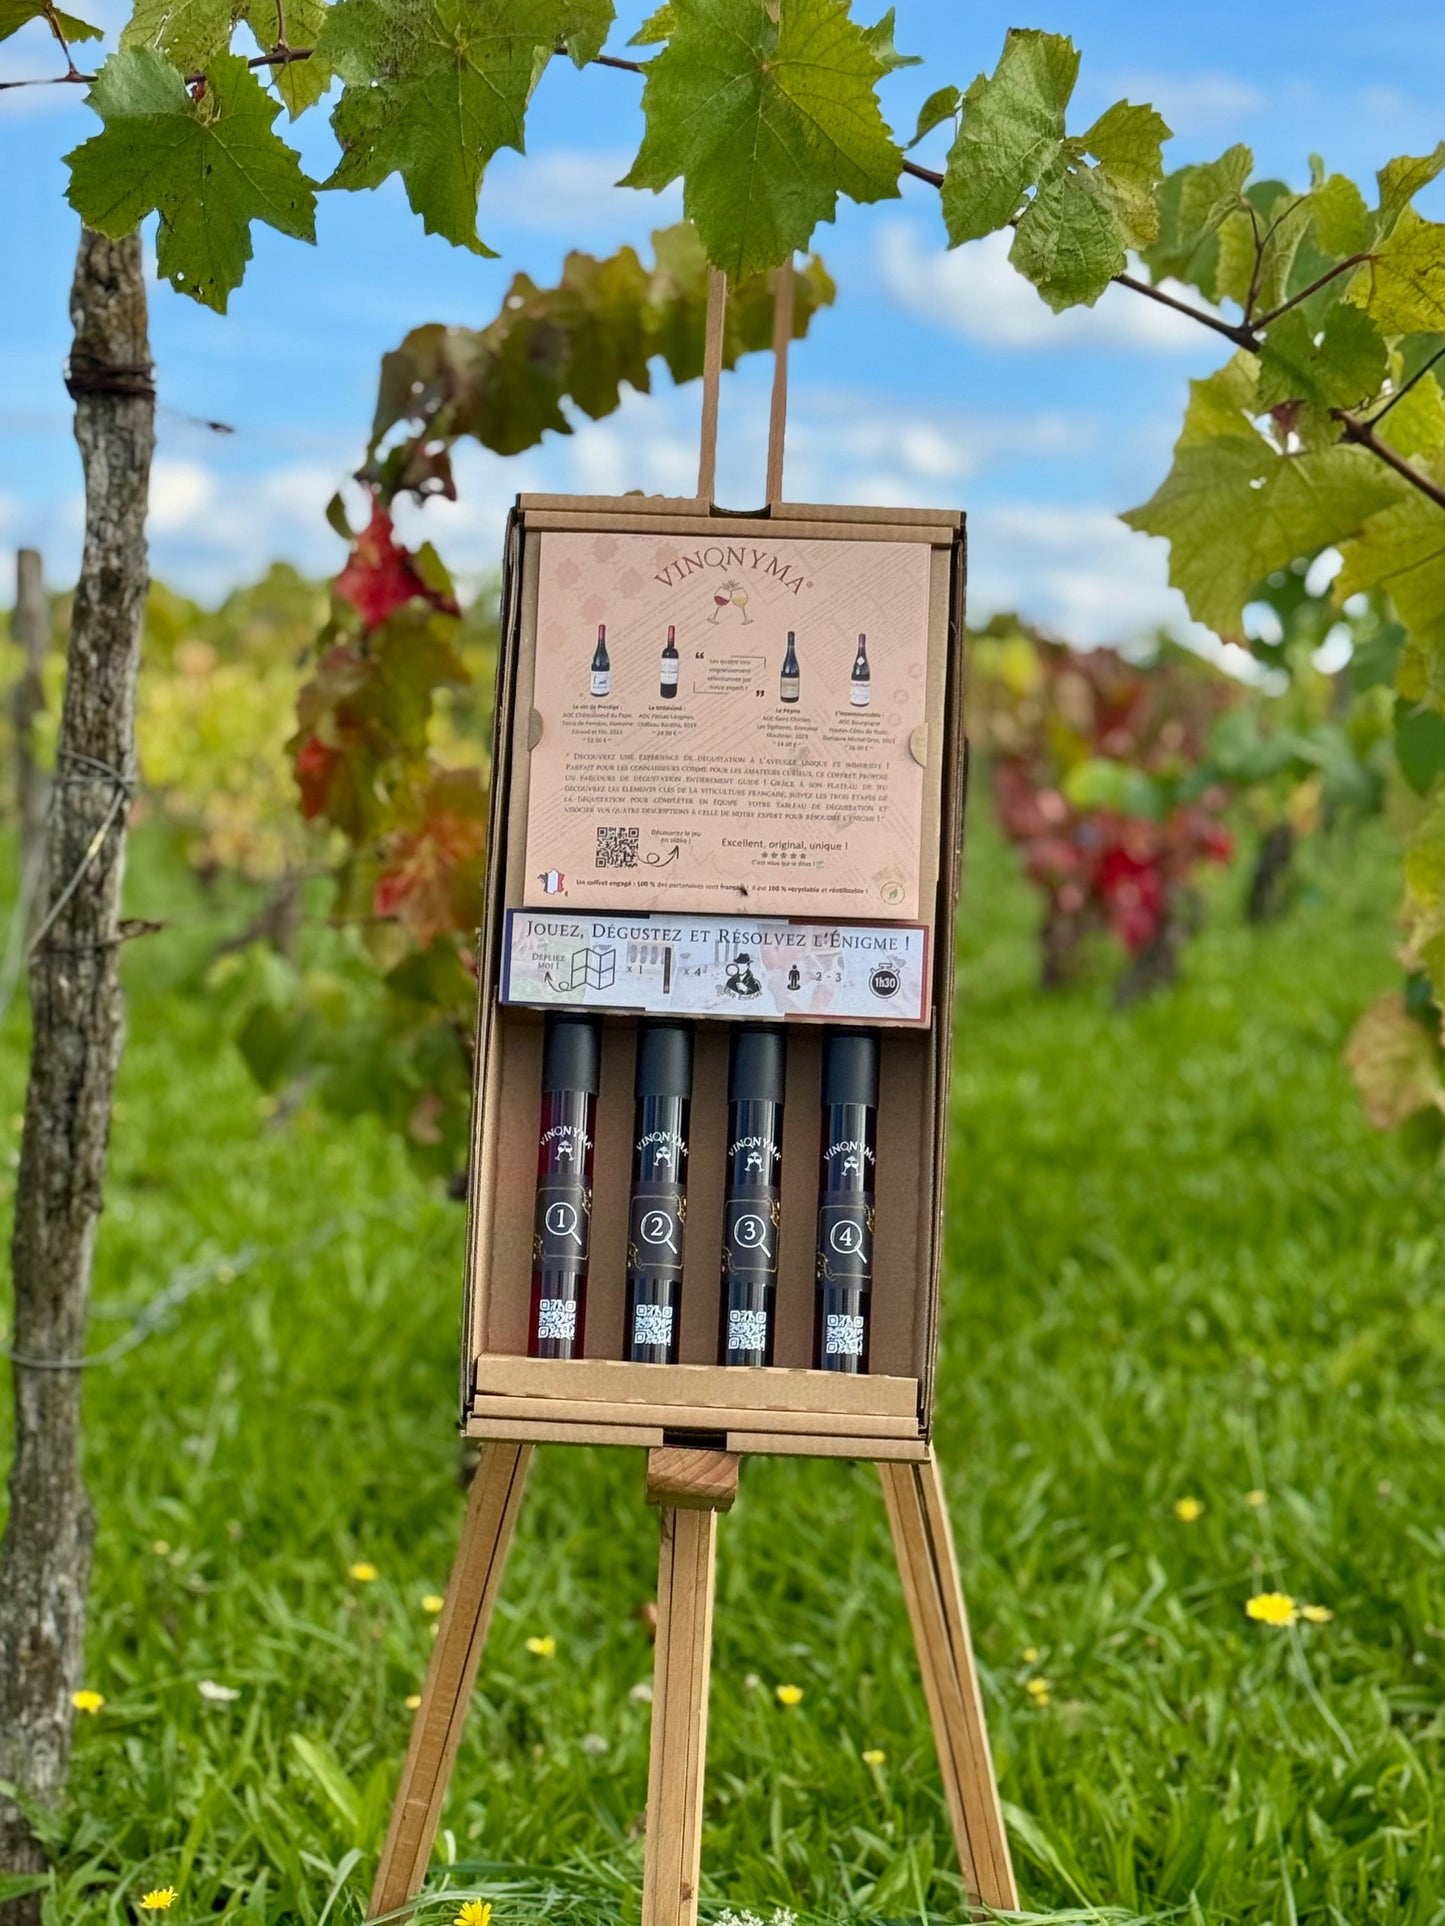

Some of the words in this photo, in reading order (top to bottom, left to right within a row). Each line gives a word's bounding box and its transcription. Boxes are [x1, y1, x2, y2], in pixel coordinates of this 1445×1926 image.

[721, 839, 766, 850] Excellent,
[768, 841, 807, 851] original,
[810, 842, 842, 853] unique
[527, 920, 584, 940] JOUEZ,
[592, 923, 682, 944] DÉGUSTEZ
[690, 930, 711, 945] ET
[719, 929, 806, 947] RÉSOLVEZ
[814, 930, 898, 950] L'ÉNIGME
[905, 936, 909, 951] !
[538, 962, 554, 970] MOI
[815, 972, 822, 982] 2
[835, 973, 842, 982] 3
[875, 976, 896, 990] 1h30
[556, 1208, 566, 1228] 1
[650, 1216, 664, 1237] 2
[744, 1220, 756, 1241] 3
[839, 1226, 853, 1247] 4
